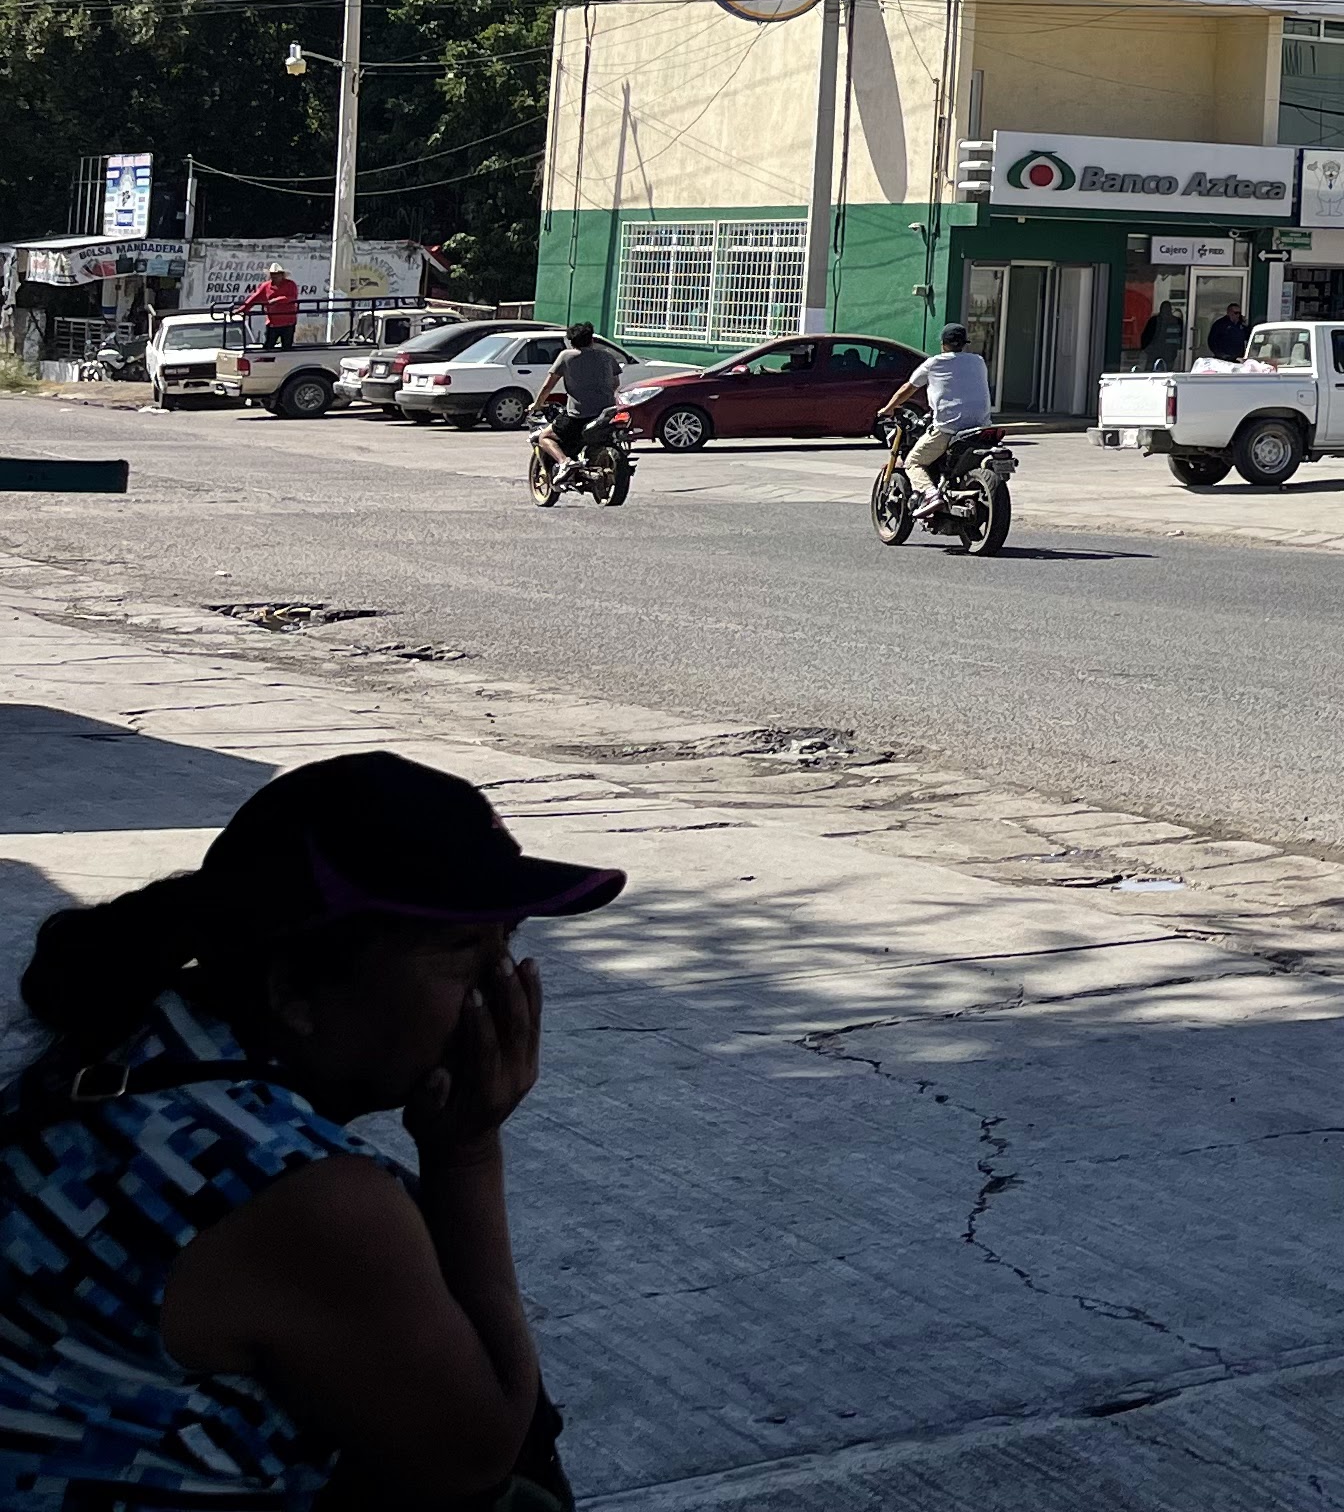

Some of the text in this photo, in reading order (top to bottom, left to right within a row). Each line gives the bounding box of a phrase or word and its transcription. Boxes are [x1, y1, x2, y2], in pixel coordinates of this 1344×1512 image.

[1079, 166, 1286, 200] Banco Azteca
[79, 243, 184, 259] BOLSA MANDADERA
[1159, 244, 1188, 256] Cajero
[206, 282, 240, 293] BOLSA
